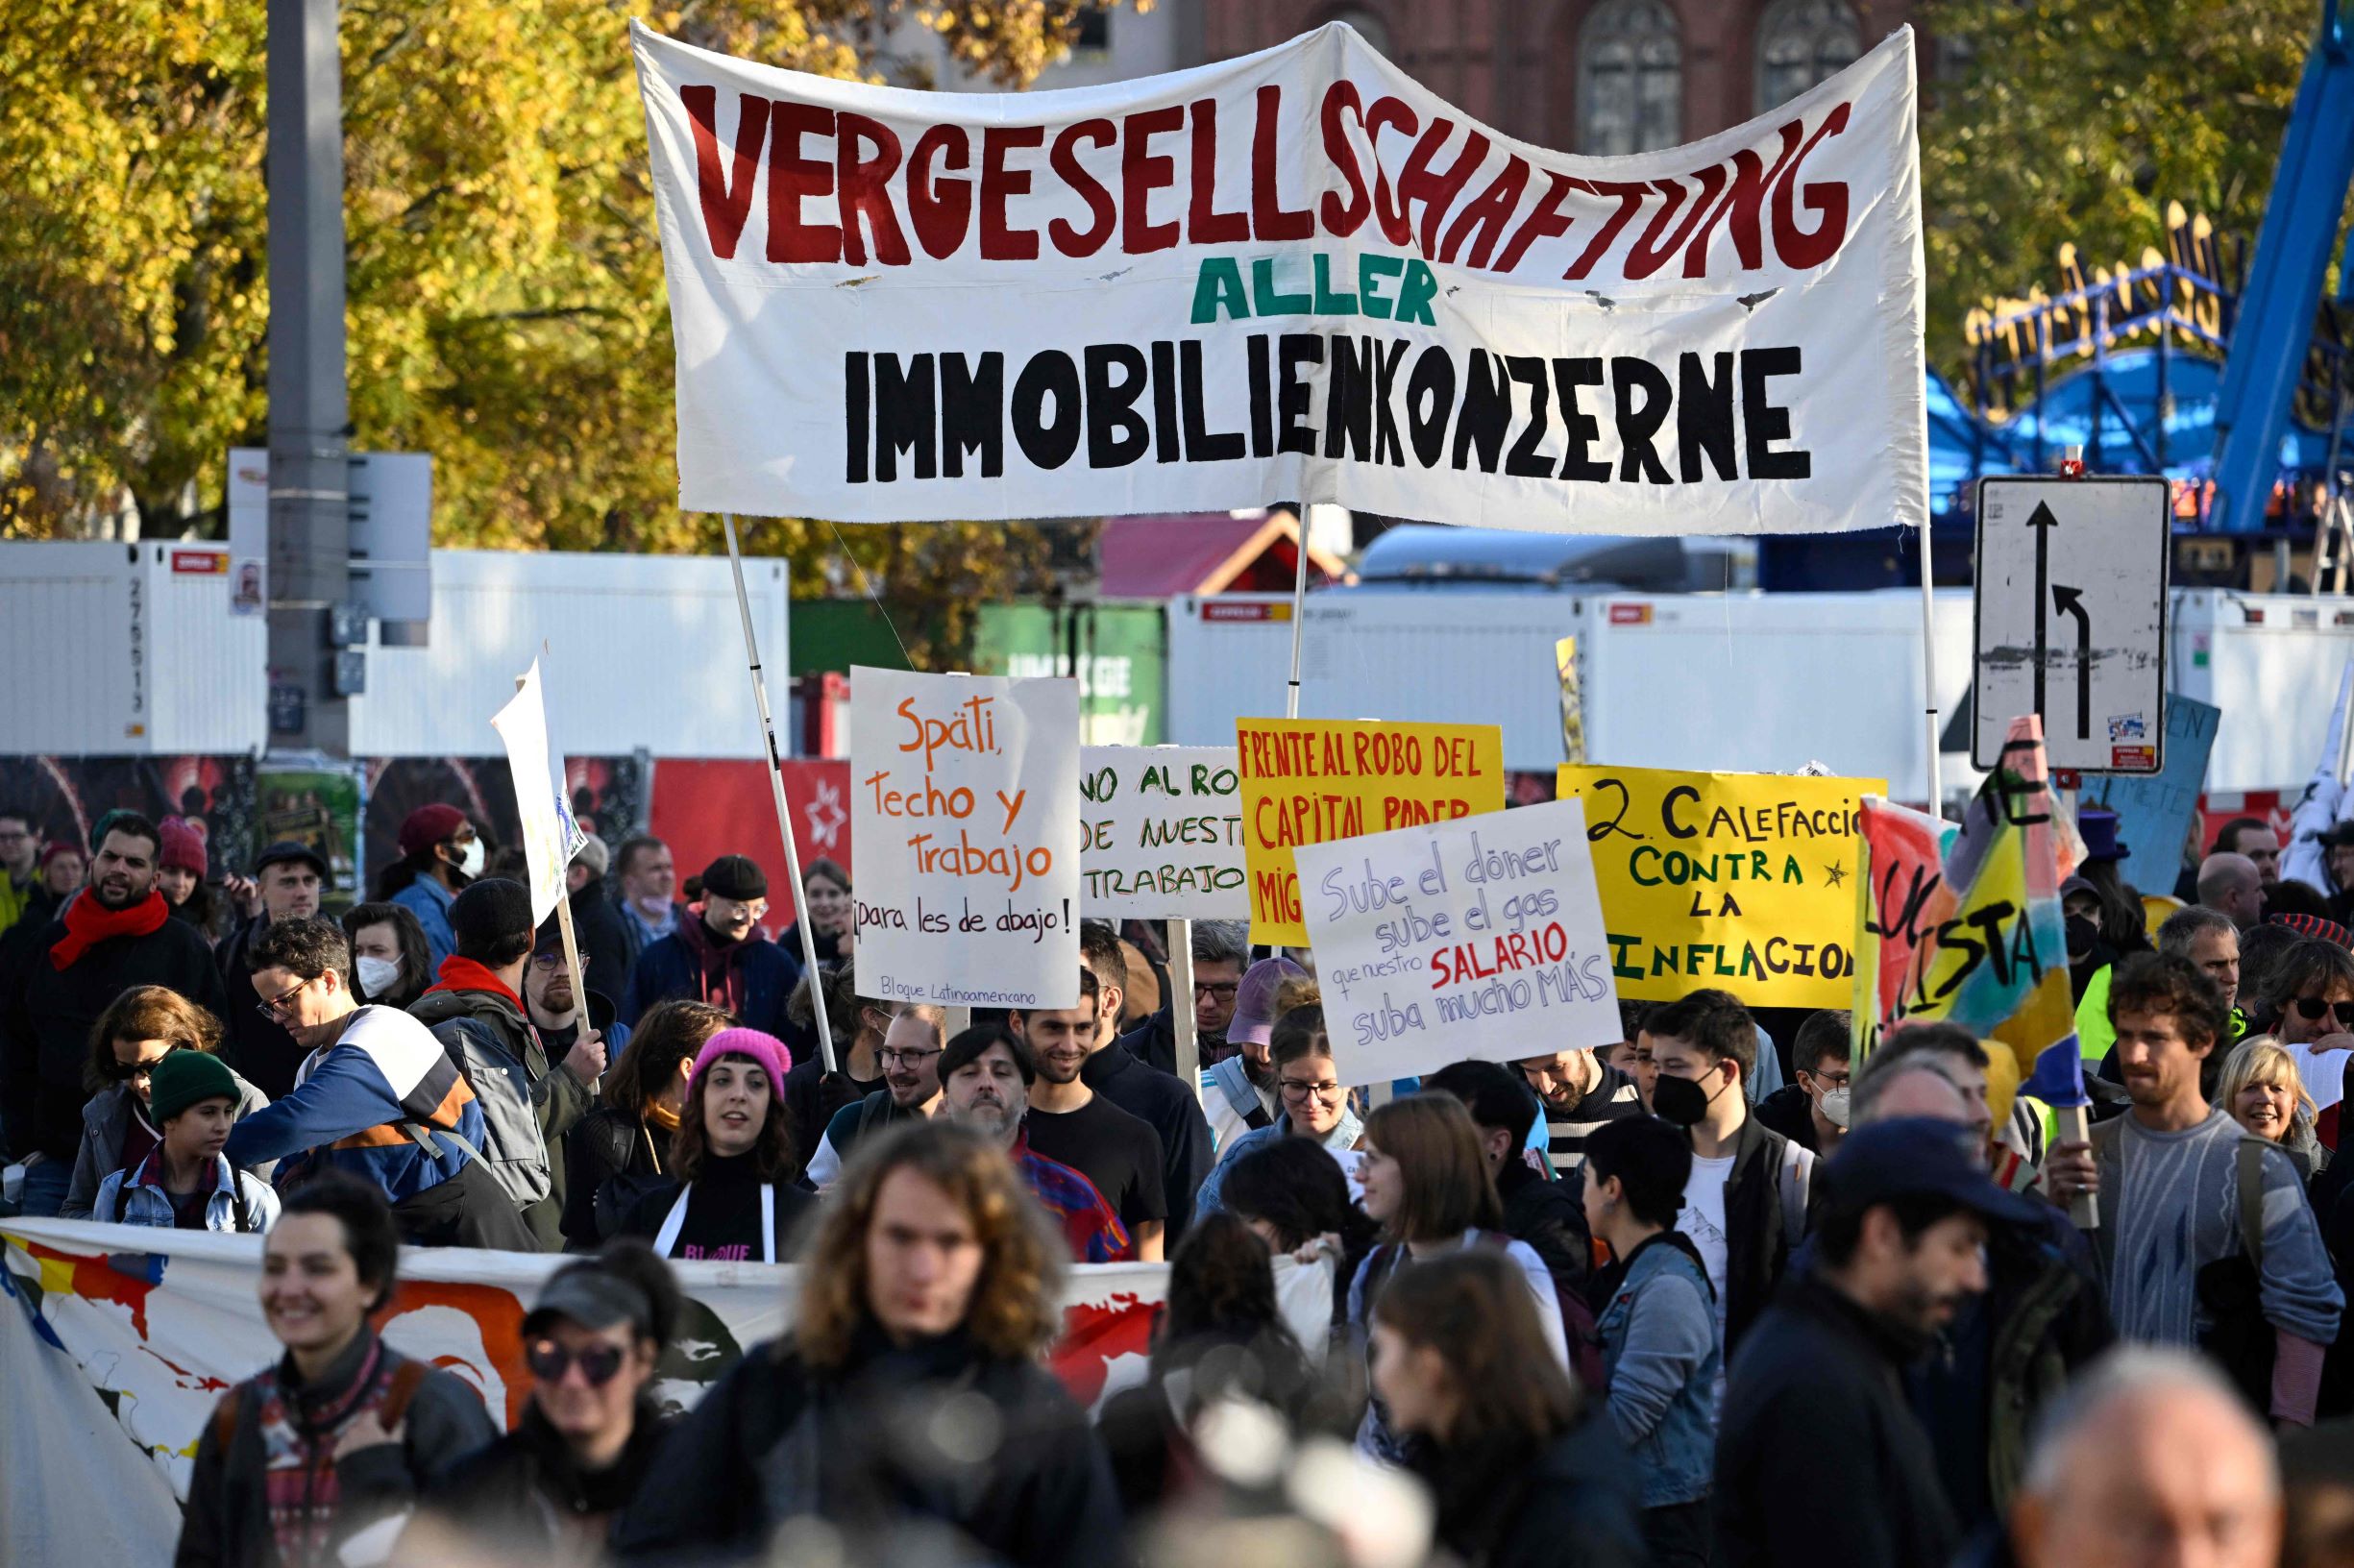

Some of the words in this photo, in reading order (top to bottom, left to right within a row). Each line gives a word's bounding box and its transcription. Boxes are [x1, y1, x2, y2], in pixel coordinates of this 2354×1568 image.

[680, 80, 1851, 281] VERGESELLSCHAFTUNG
[1190, 254, 1437, 326] ALLER
[846, 334, 1811, 484] IMMOBILIENKONZERNE
[1135, 764, 1181, 796] AL
[1238, 729, 1318, 777] FRENTE
[1323, 731, 1351, 776] AL
[1354, 731, 1422, 776] ROBO
[1434, 736, 1482, 777] DEL
[866, 771, 975, 819] Techo
[996, 790, 1026, 835] y
[1140, 815, 1246, 847] NUEST
[908, 829, 1052, 893] Trabajo
[1084, 865, 1245, 898] TRABAJO
[1322, 859, 1408, 922] Sube
[1418, 842, 1448, 895] el
[1465, 831, 1561, 884] döner
[1630, 845, 1803, 886] CONTRA
[918, 896, 949, 933] les
[959, 896, 987, 932] de
[1376, 906, 1451, 953] sube
[1464, 888, 1492, 930] el
[1503, 889, 1559, 935] gas
[1689, 891, 1743, 918] LA
[881, 976, 925, 1003] Bloque
[931, 983, 1036, 1005] Latinoamericano
[1332, 968, 1361, 1001] que
[1362, 951, 1423, 979] nuestro
[1431, 921, 1567, 991] SALARIO
[1353, 992, 1426, 1046] suba
[1435, 978, 1532, 1023] mucho
[1535, 951, 1607, 1007] MÁS
